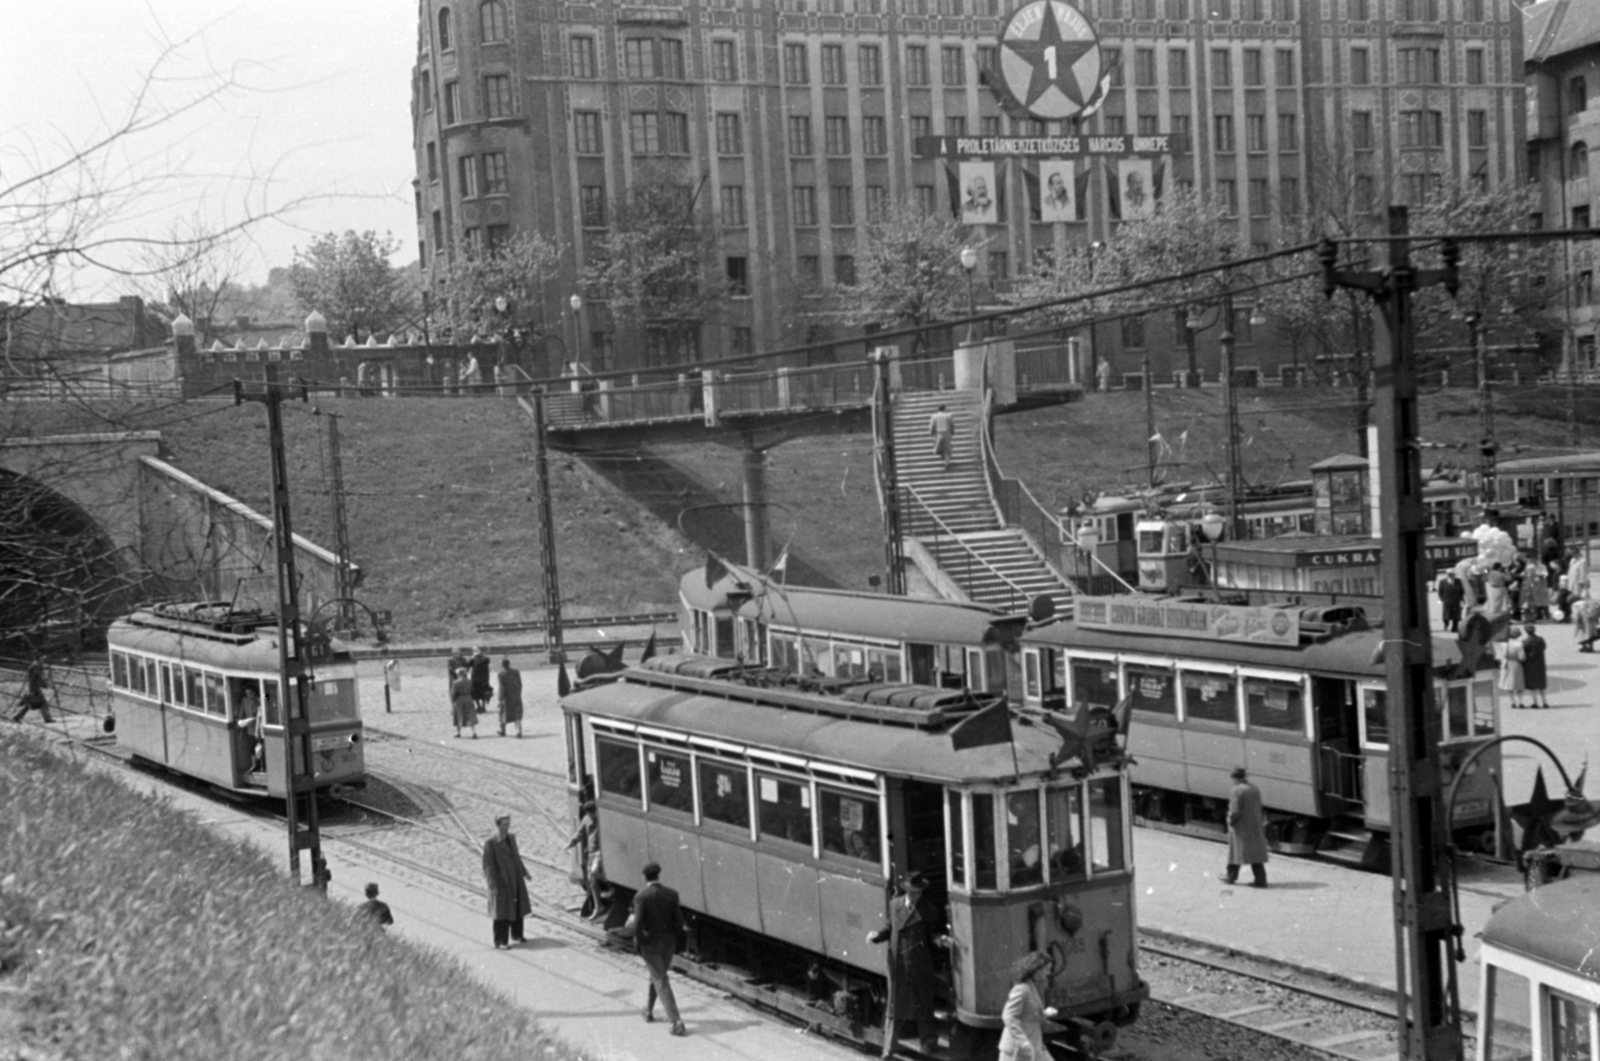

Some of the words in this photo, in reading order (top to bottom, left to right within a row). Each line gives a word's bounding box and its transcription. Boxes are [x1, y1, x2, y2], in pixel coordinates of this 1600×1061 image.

[1043, 45, 1057, 80] 1
[940, 138, 948, 154] A
[1088, 136, 1125, 153] HARCOS
